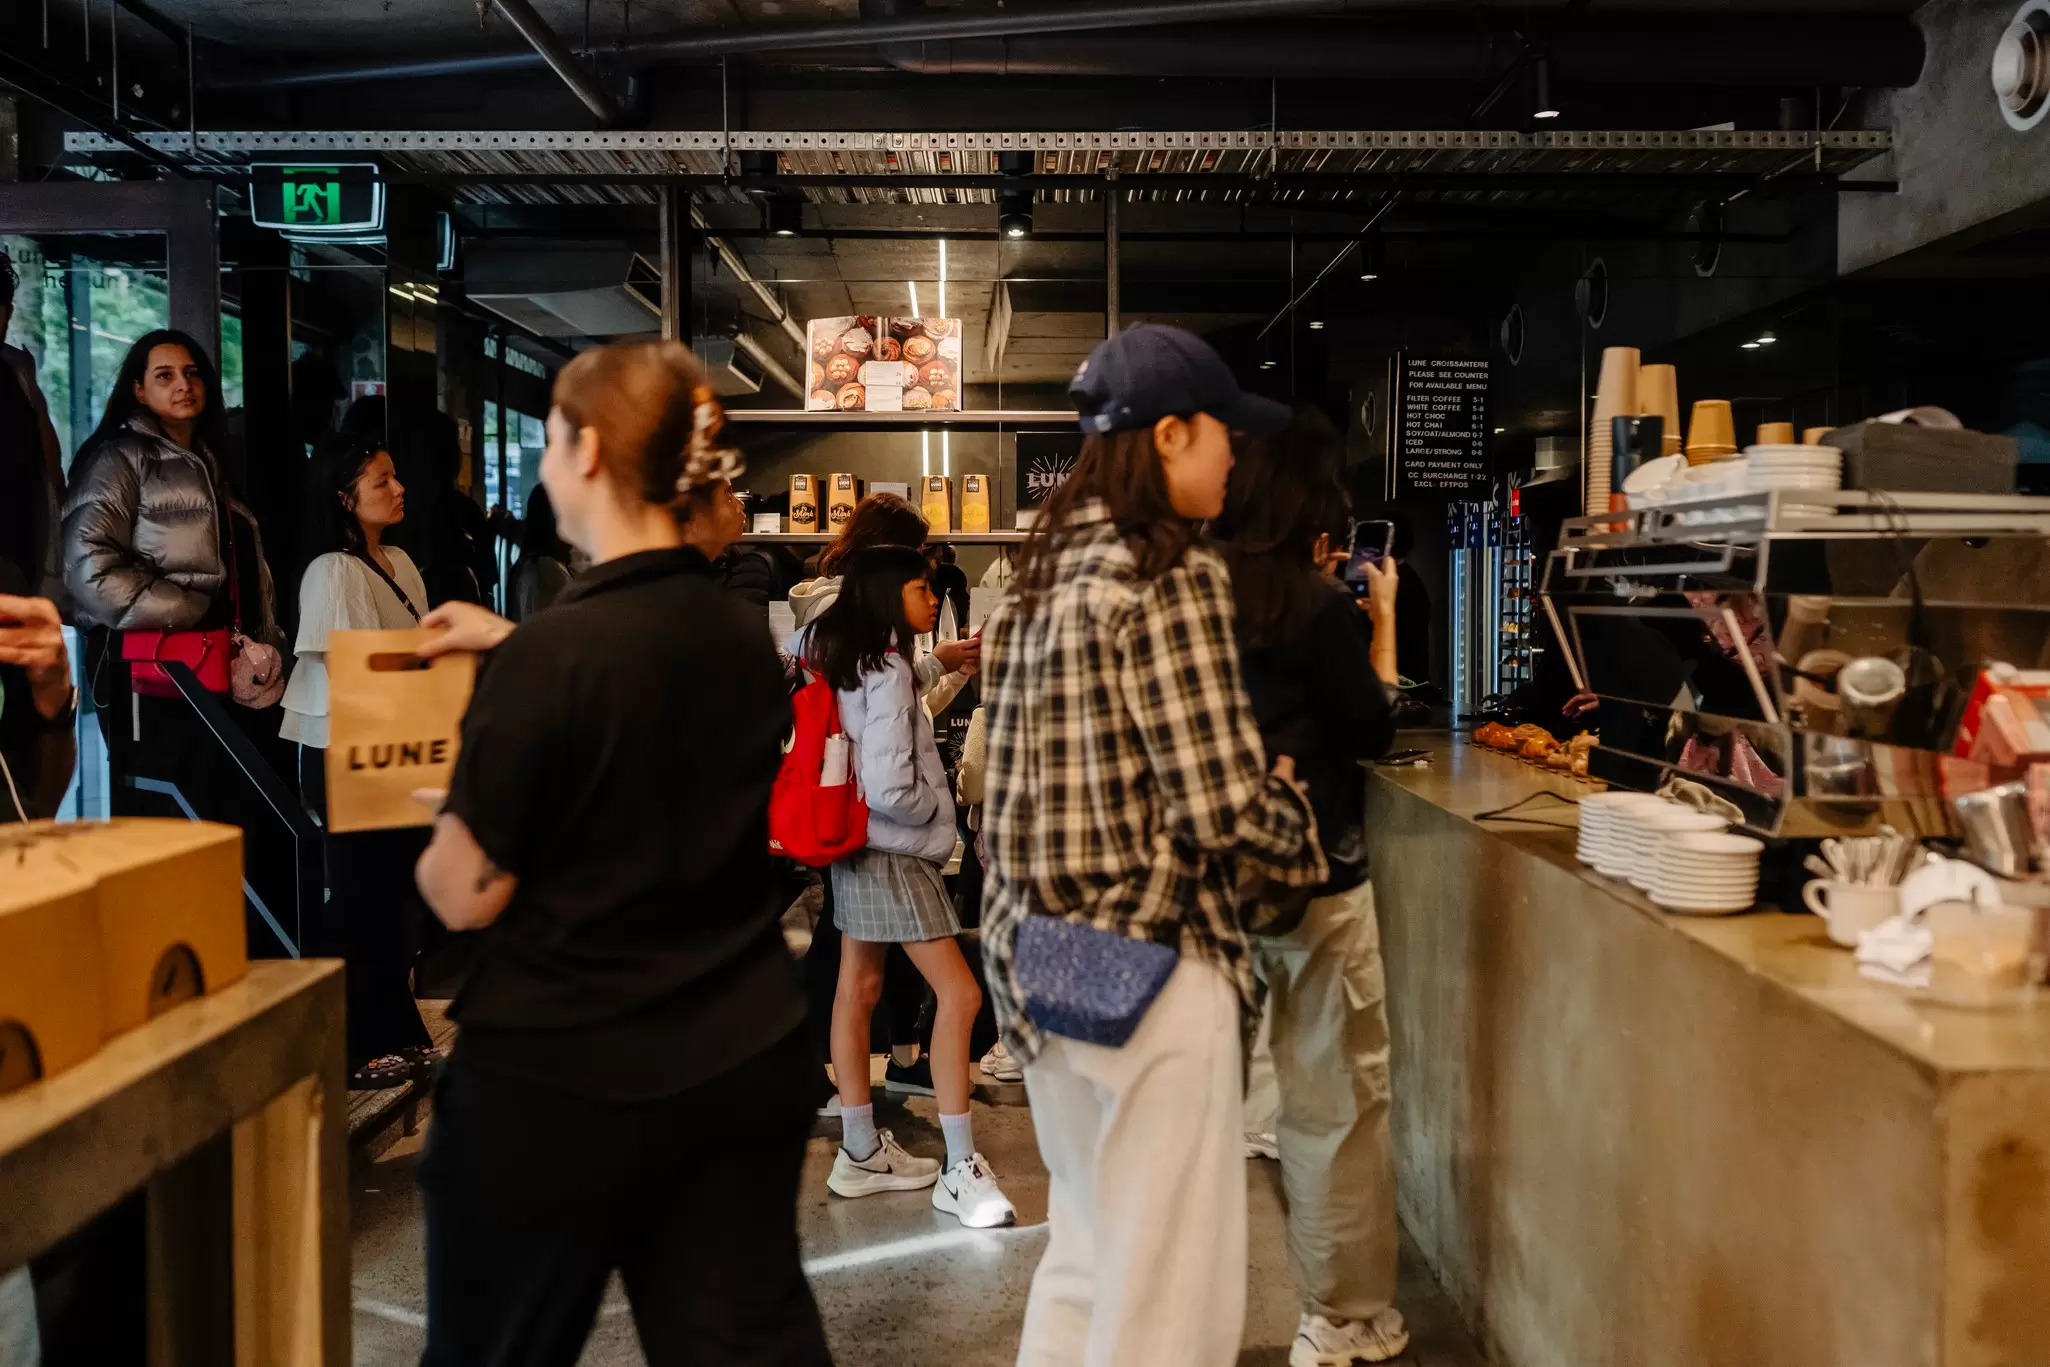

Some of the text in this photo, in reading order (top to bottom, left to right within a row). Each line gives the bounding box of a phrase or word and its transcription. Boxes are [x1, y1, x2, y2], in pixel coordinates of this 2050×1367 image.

[1027, 473, 1071, 487] LUN
[951, 718, 970, 727] LUN
[348, 740, 449, 771] LUNE
